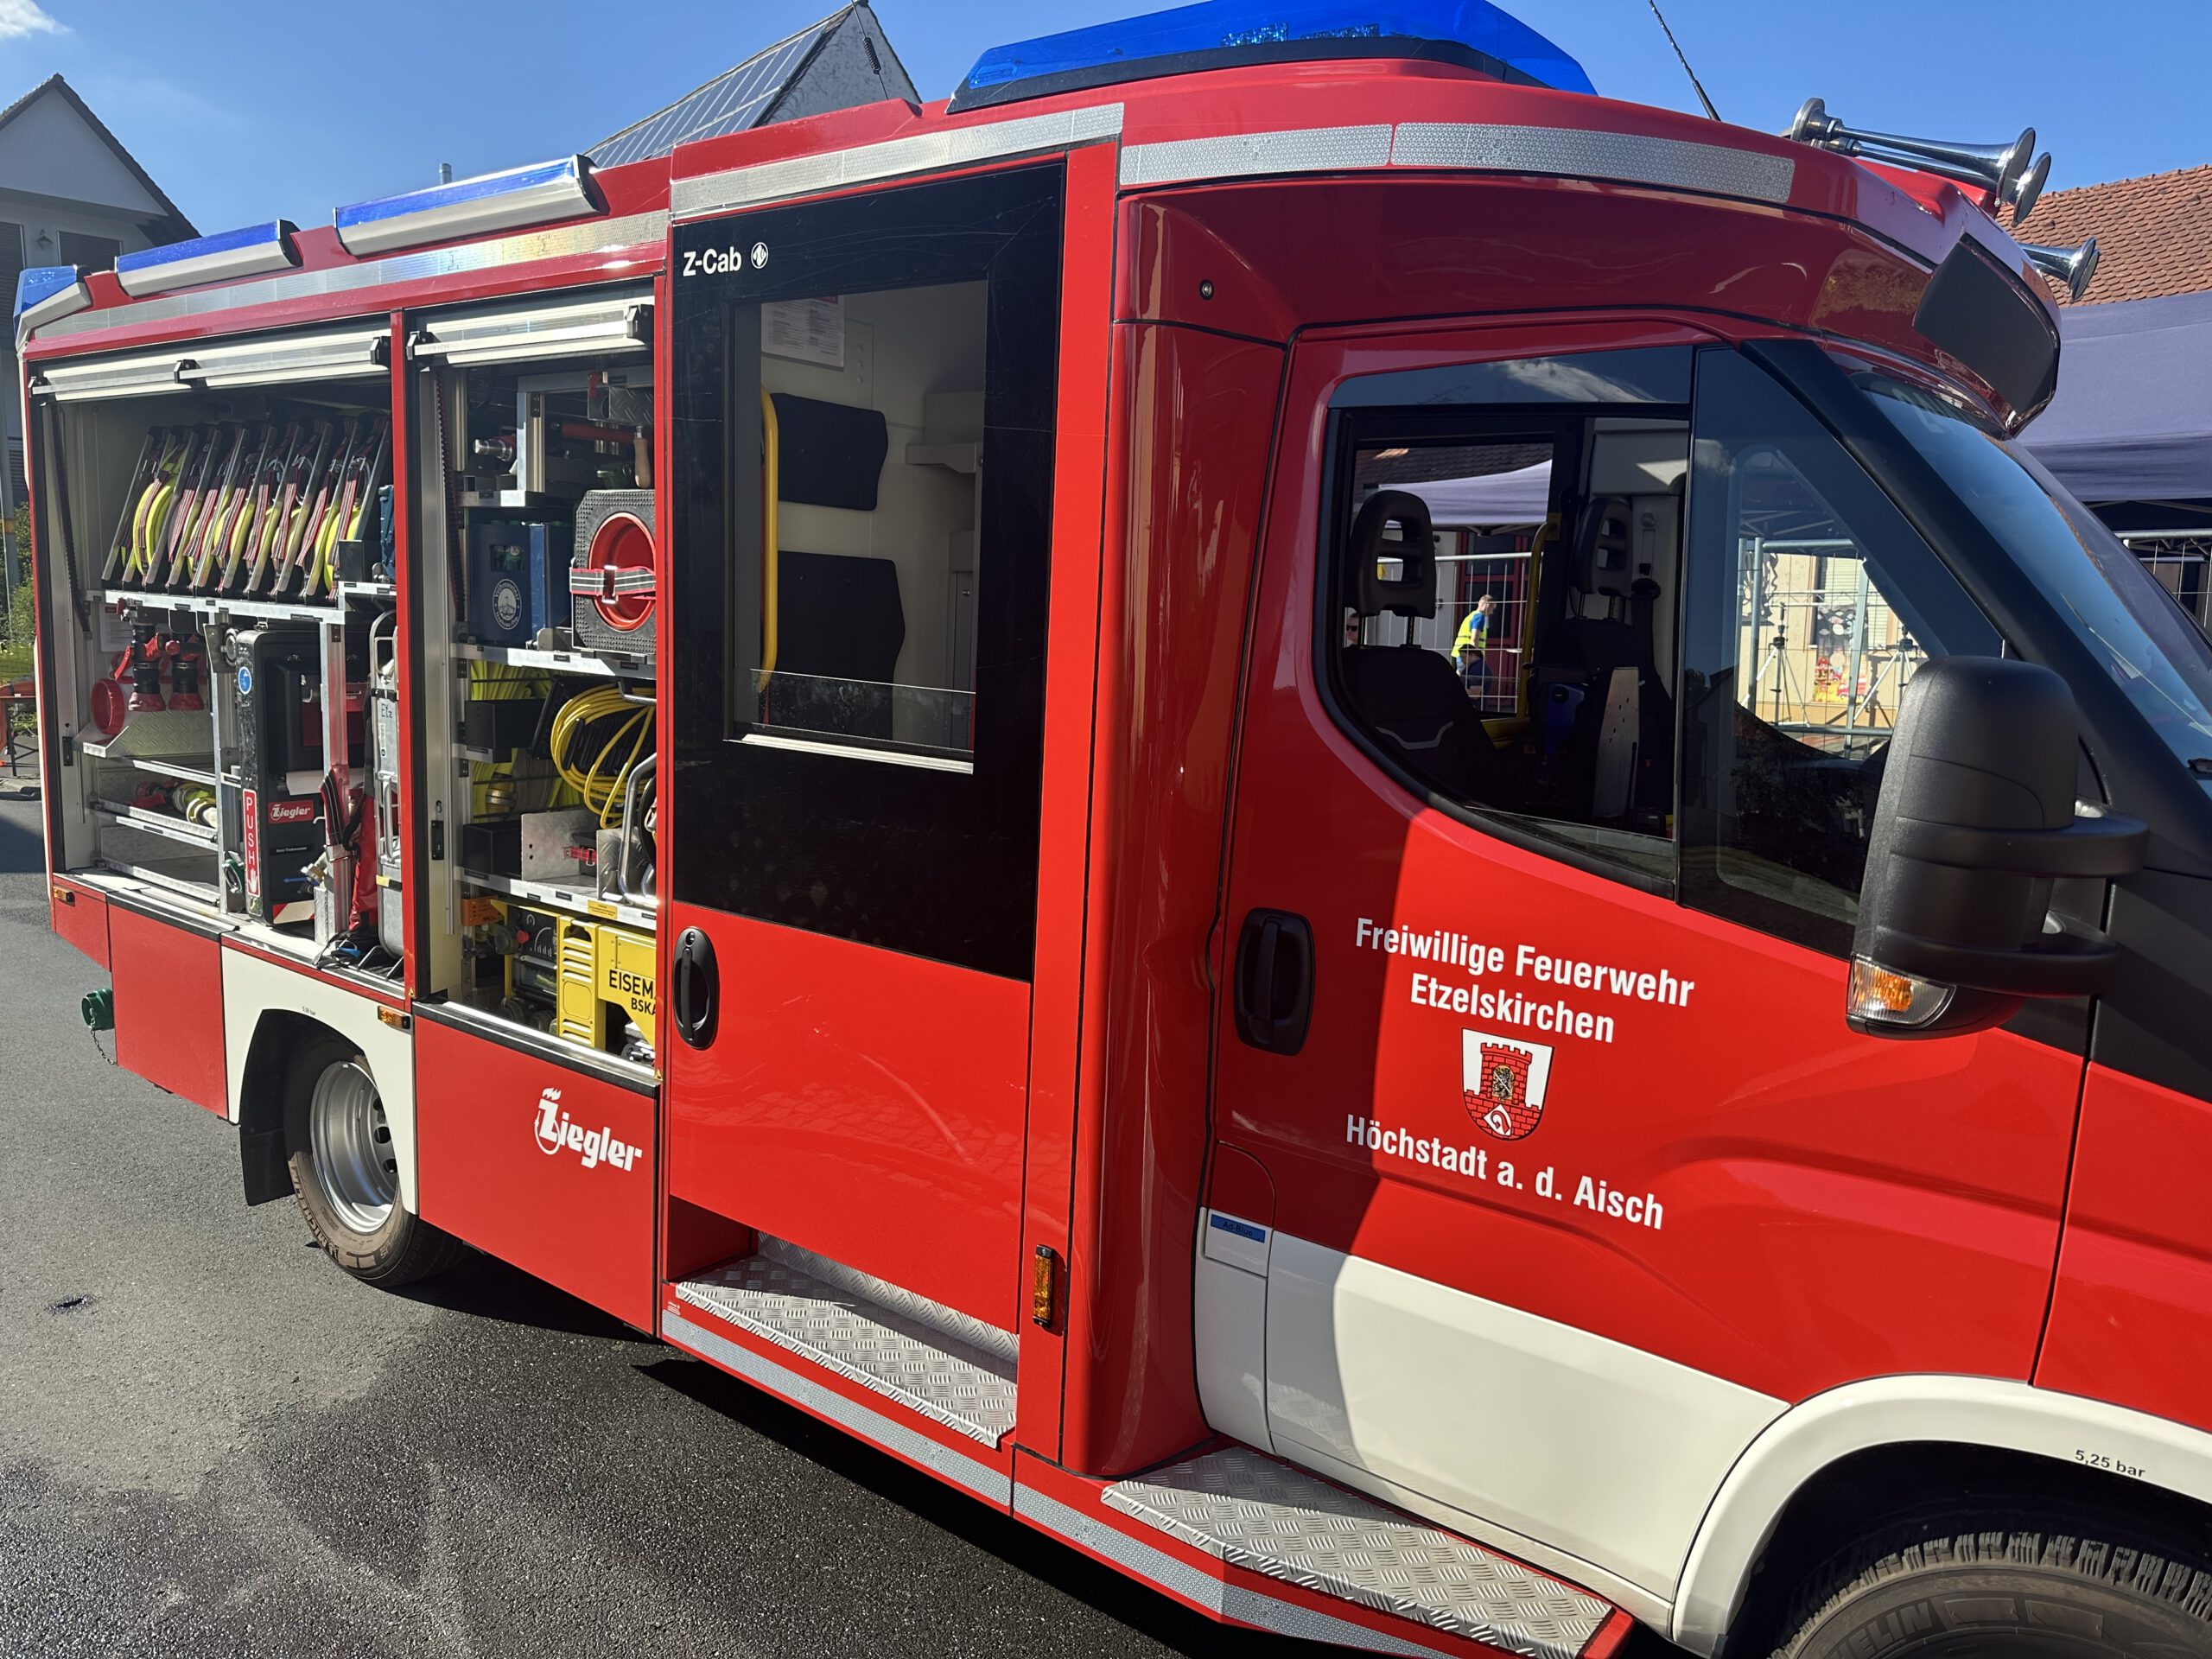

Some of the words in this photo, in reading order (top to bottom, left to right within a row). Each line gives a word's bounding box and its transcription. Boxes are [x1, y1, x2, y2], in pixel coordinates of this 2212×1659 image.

[683, 246, 742, 277] Z-Cab
[246, 798, 255, 866] PUSH
[270, 804, 311, 821] Ziegler
[609, 969, 656, 1000] EISEM
[1355, 918, 1504, 976] Freiwillige
[1515, 944, 1695, 1007] Feuerwehr
[1410, 973, 1615, 1043] Etzelskirchen
[534, 1088, 642, 1172] Ziegler
[1346, 1114, 1488, 1181] Höchstadt
[1497, 1161, 1522, 1191] a.
[1535, 1166, 1562, 1201] d.
[1573, 1175, 1664, 1230] Aisch
[2075, 1449, 2110, 1468] 5,25
[2116, 1460, 2145, 1477] bar
